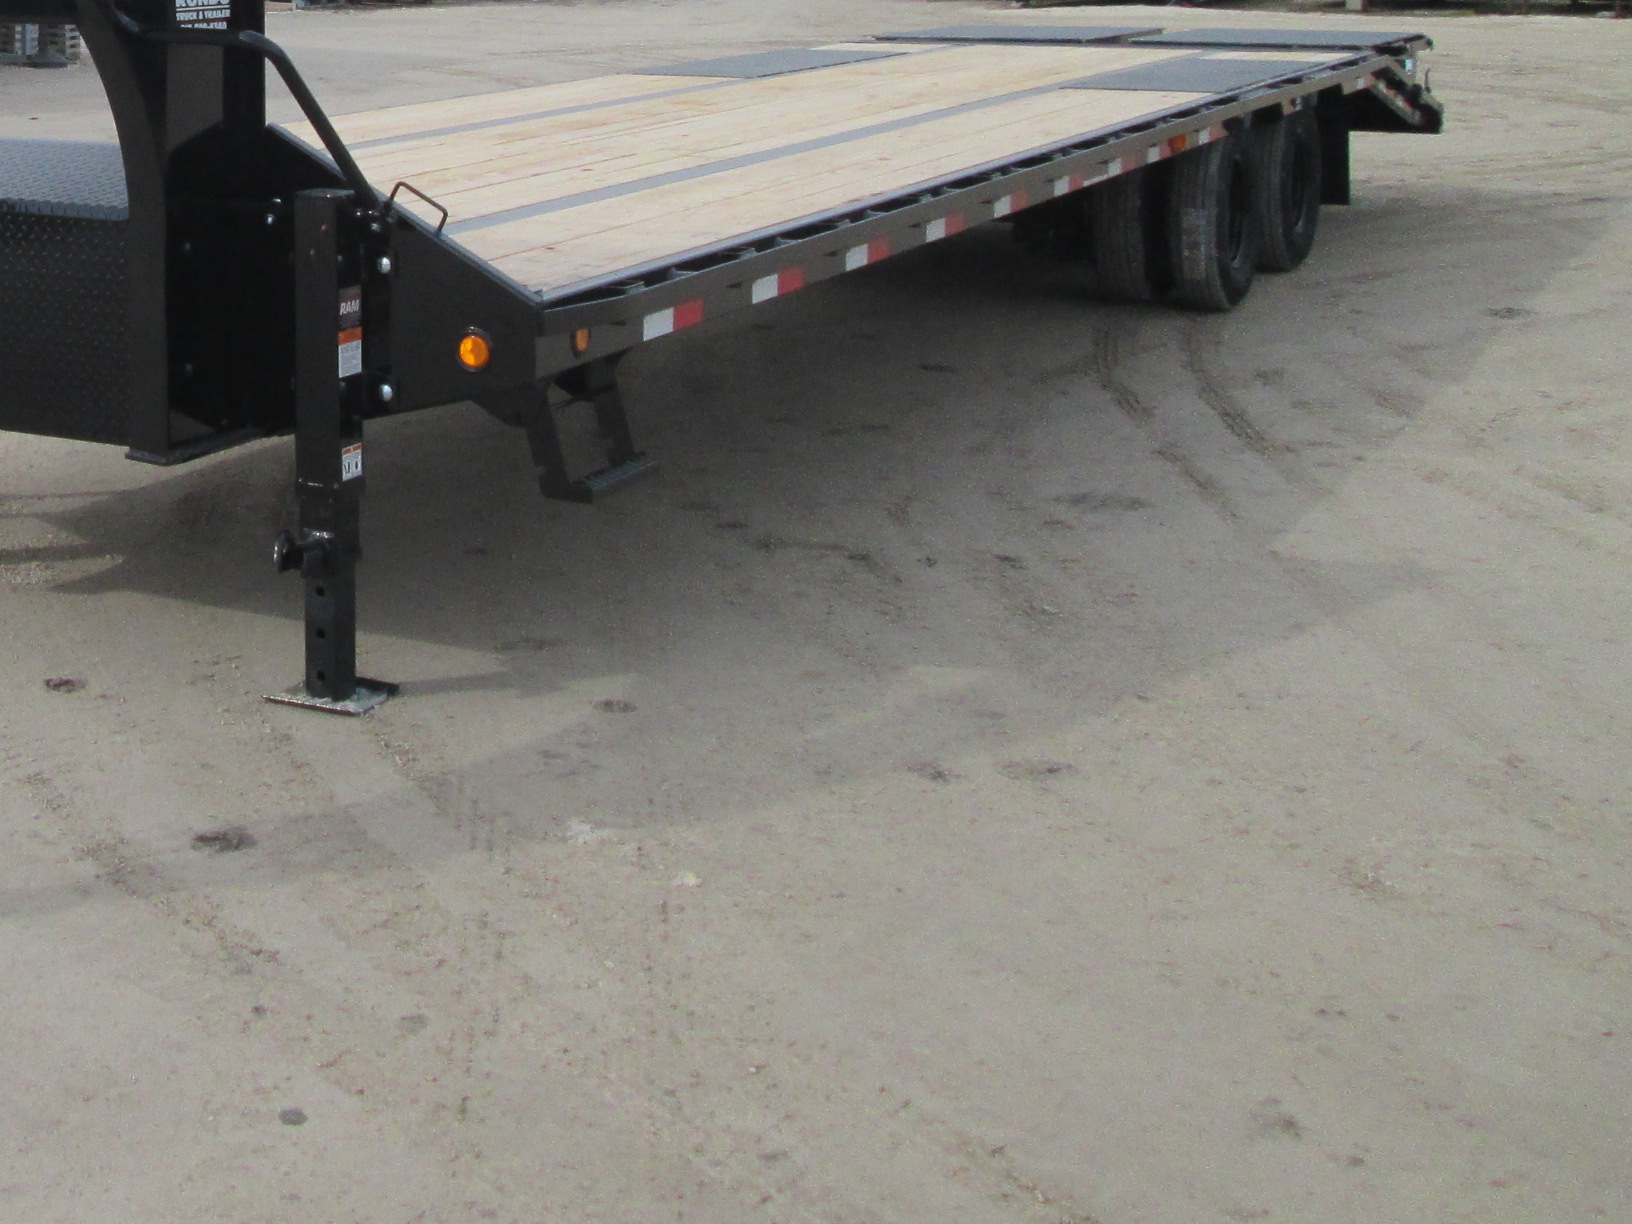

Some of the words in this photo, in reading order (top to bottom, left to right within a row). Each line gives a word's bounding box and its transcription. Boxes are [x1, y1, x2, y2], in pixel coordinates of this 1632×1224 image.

[176, 12, 197, 21] TRUCK
[204, 9, 231, 19] TRAILER
[339, 299, 360, 315] RAM
